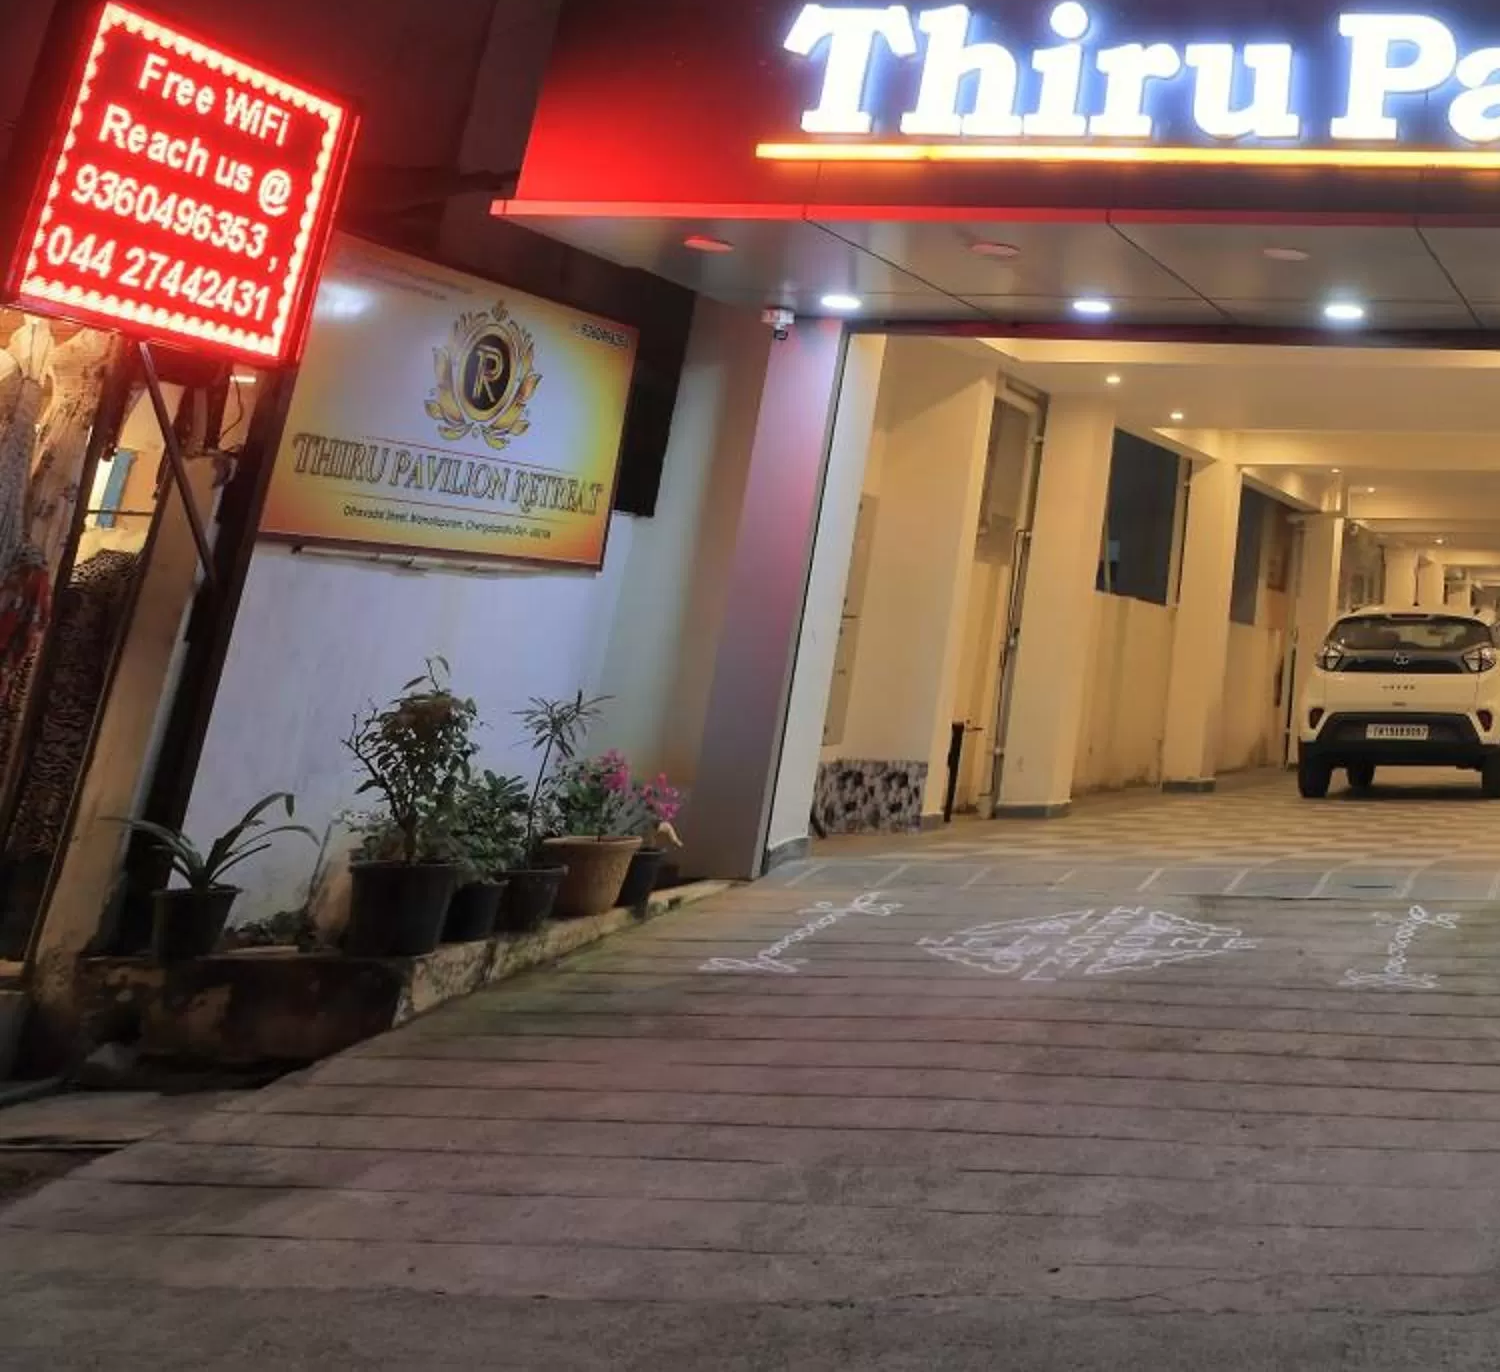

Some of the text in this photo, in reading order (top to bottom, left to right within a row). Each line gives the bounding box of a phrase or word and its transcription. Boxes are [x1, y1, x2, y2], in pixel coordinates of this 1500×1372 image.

[139, 52, 290, 147] Free WiFi
[783, 0, 1301, 140] Thiru
[98, 103, 293, 216] Reach us @
[45, 225, 271, 322] 044 27442431
[293, 432, 605, 515] THIRU PAVILION RETREAT
